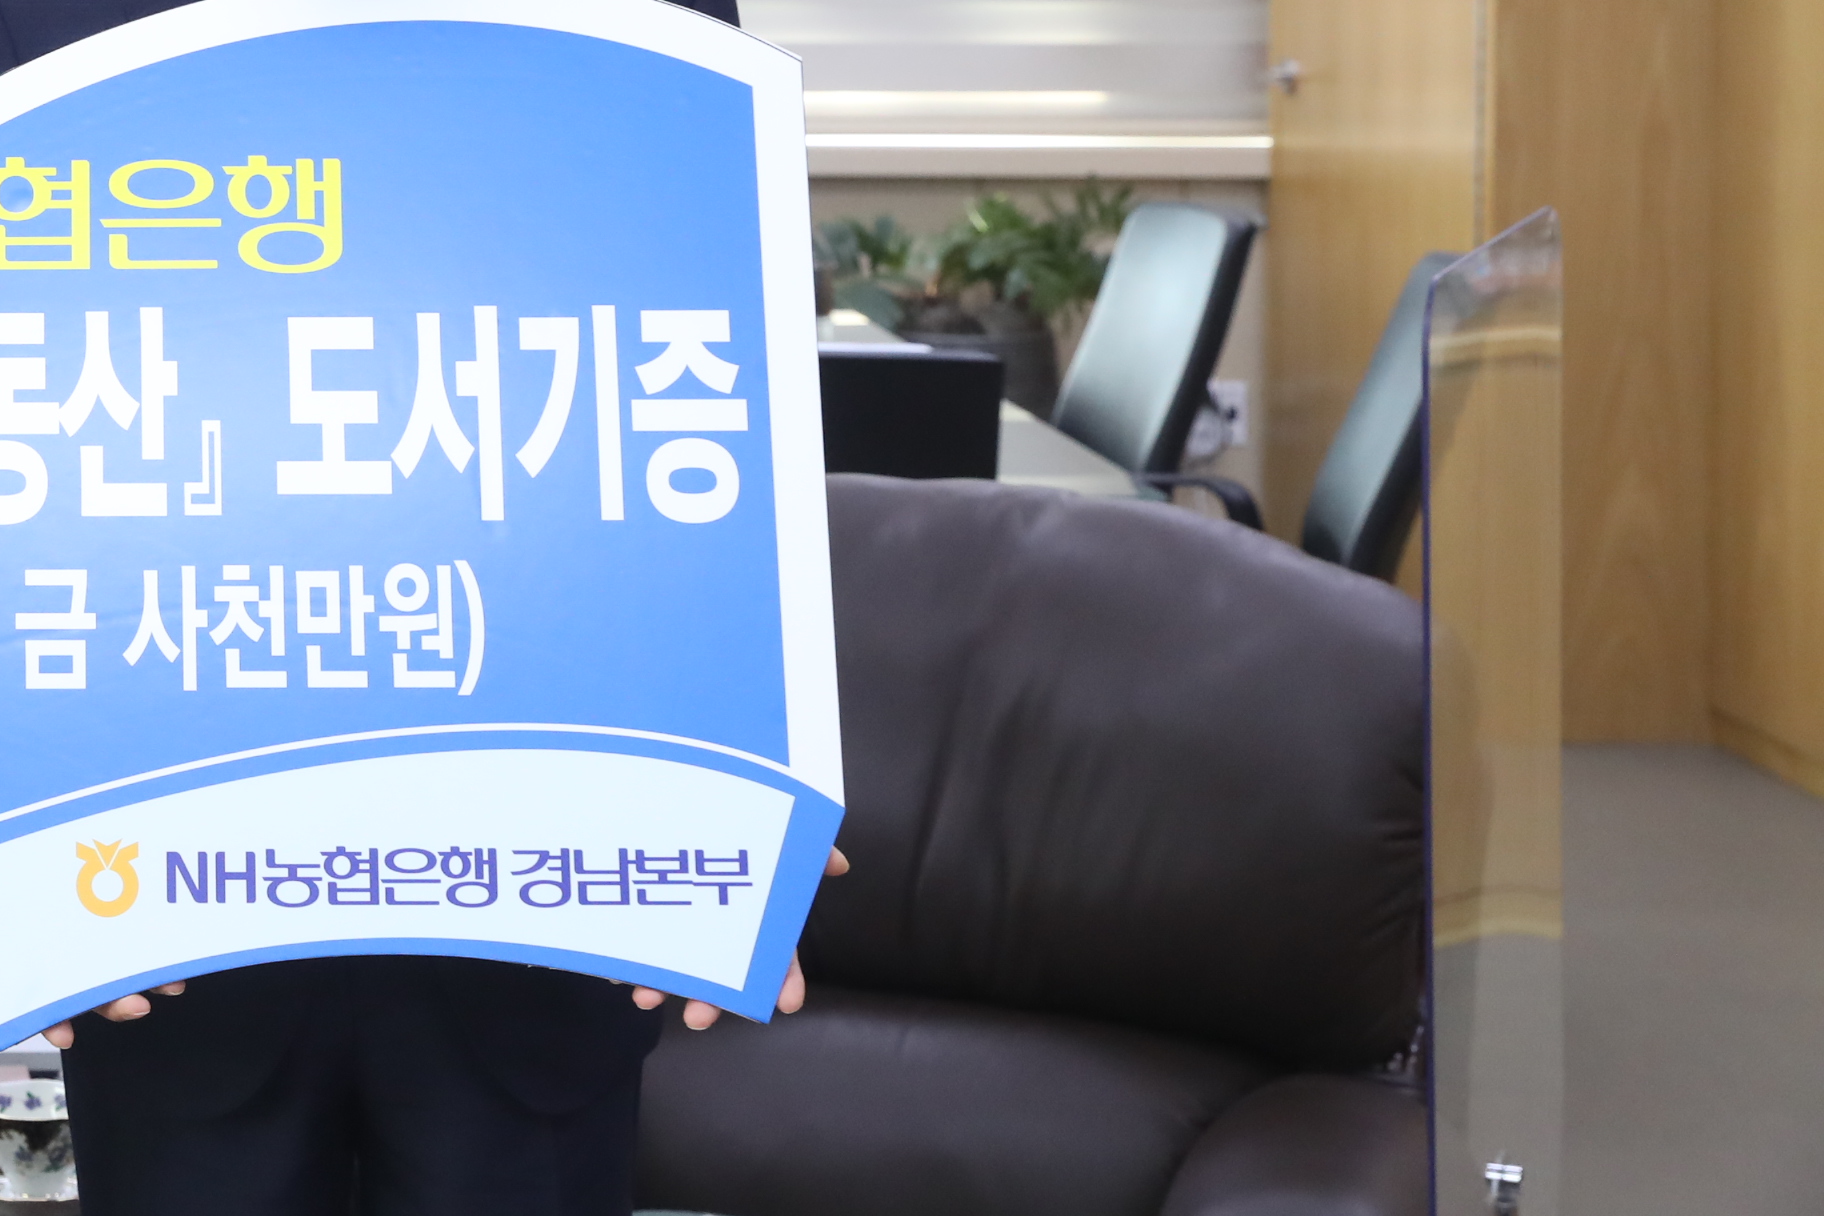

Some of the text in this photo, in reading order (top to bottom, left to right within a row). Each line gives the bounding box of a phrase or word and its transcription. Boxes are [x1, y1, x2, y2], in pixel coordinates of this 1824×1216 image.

[276, 304, 749, 525] 도서기증
[14, 568, 97, 691] 금
[122, 559, 485, 696] 사천만원)
[165, 845, 754, 910] NH농협은행 경남본부
